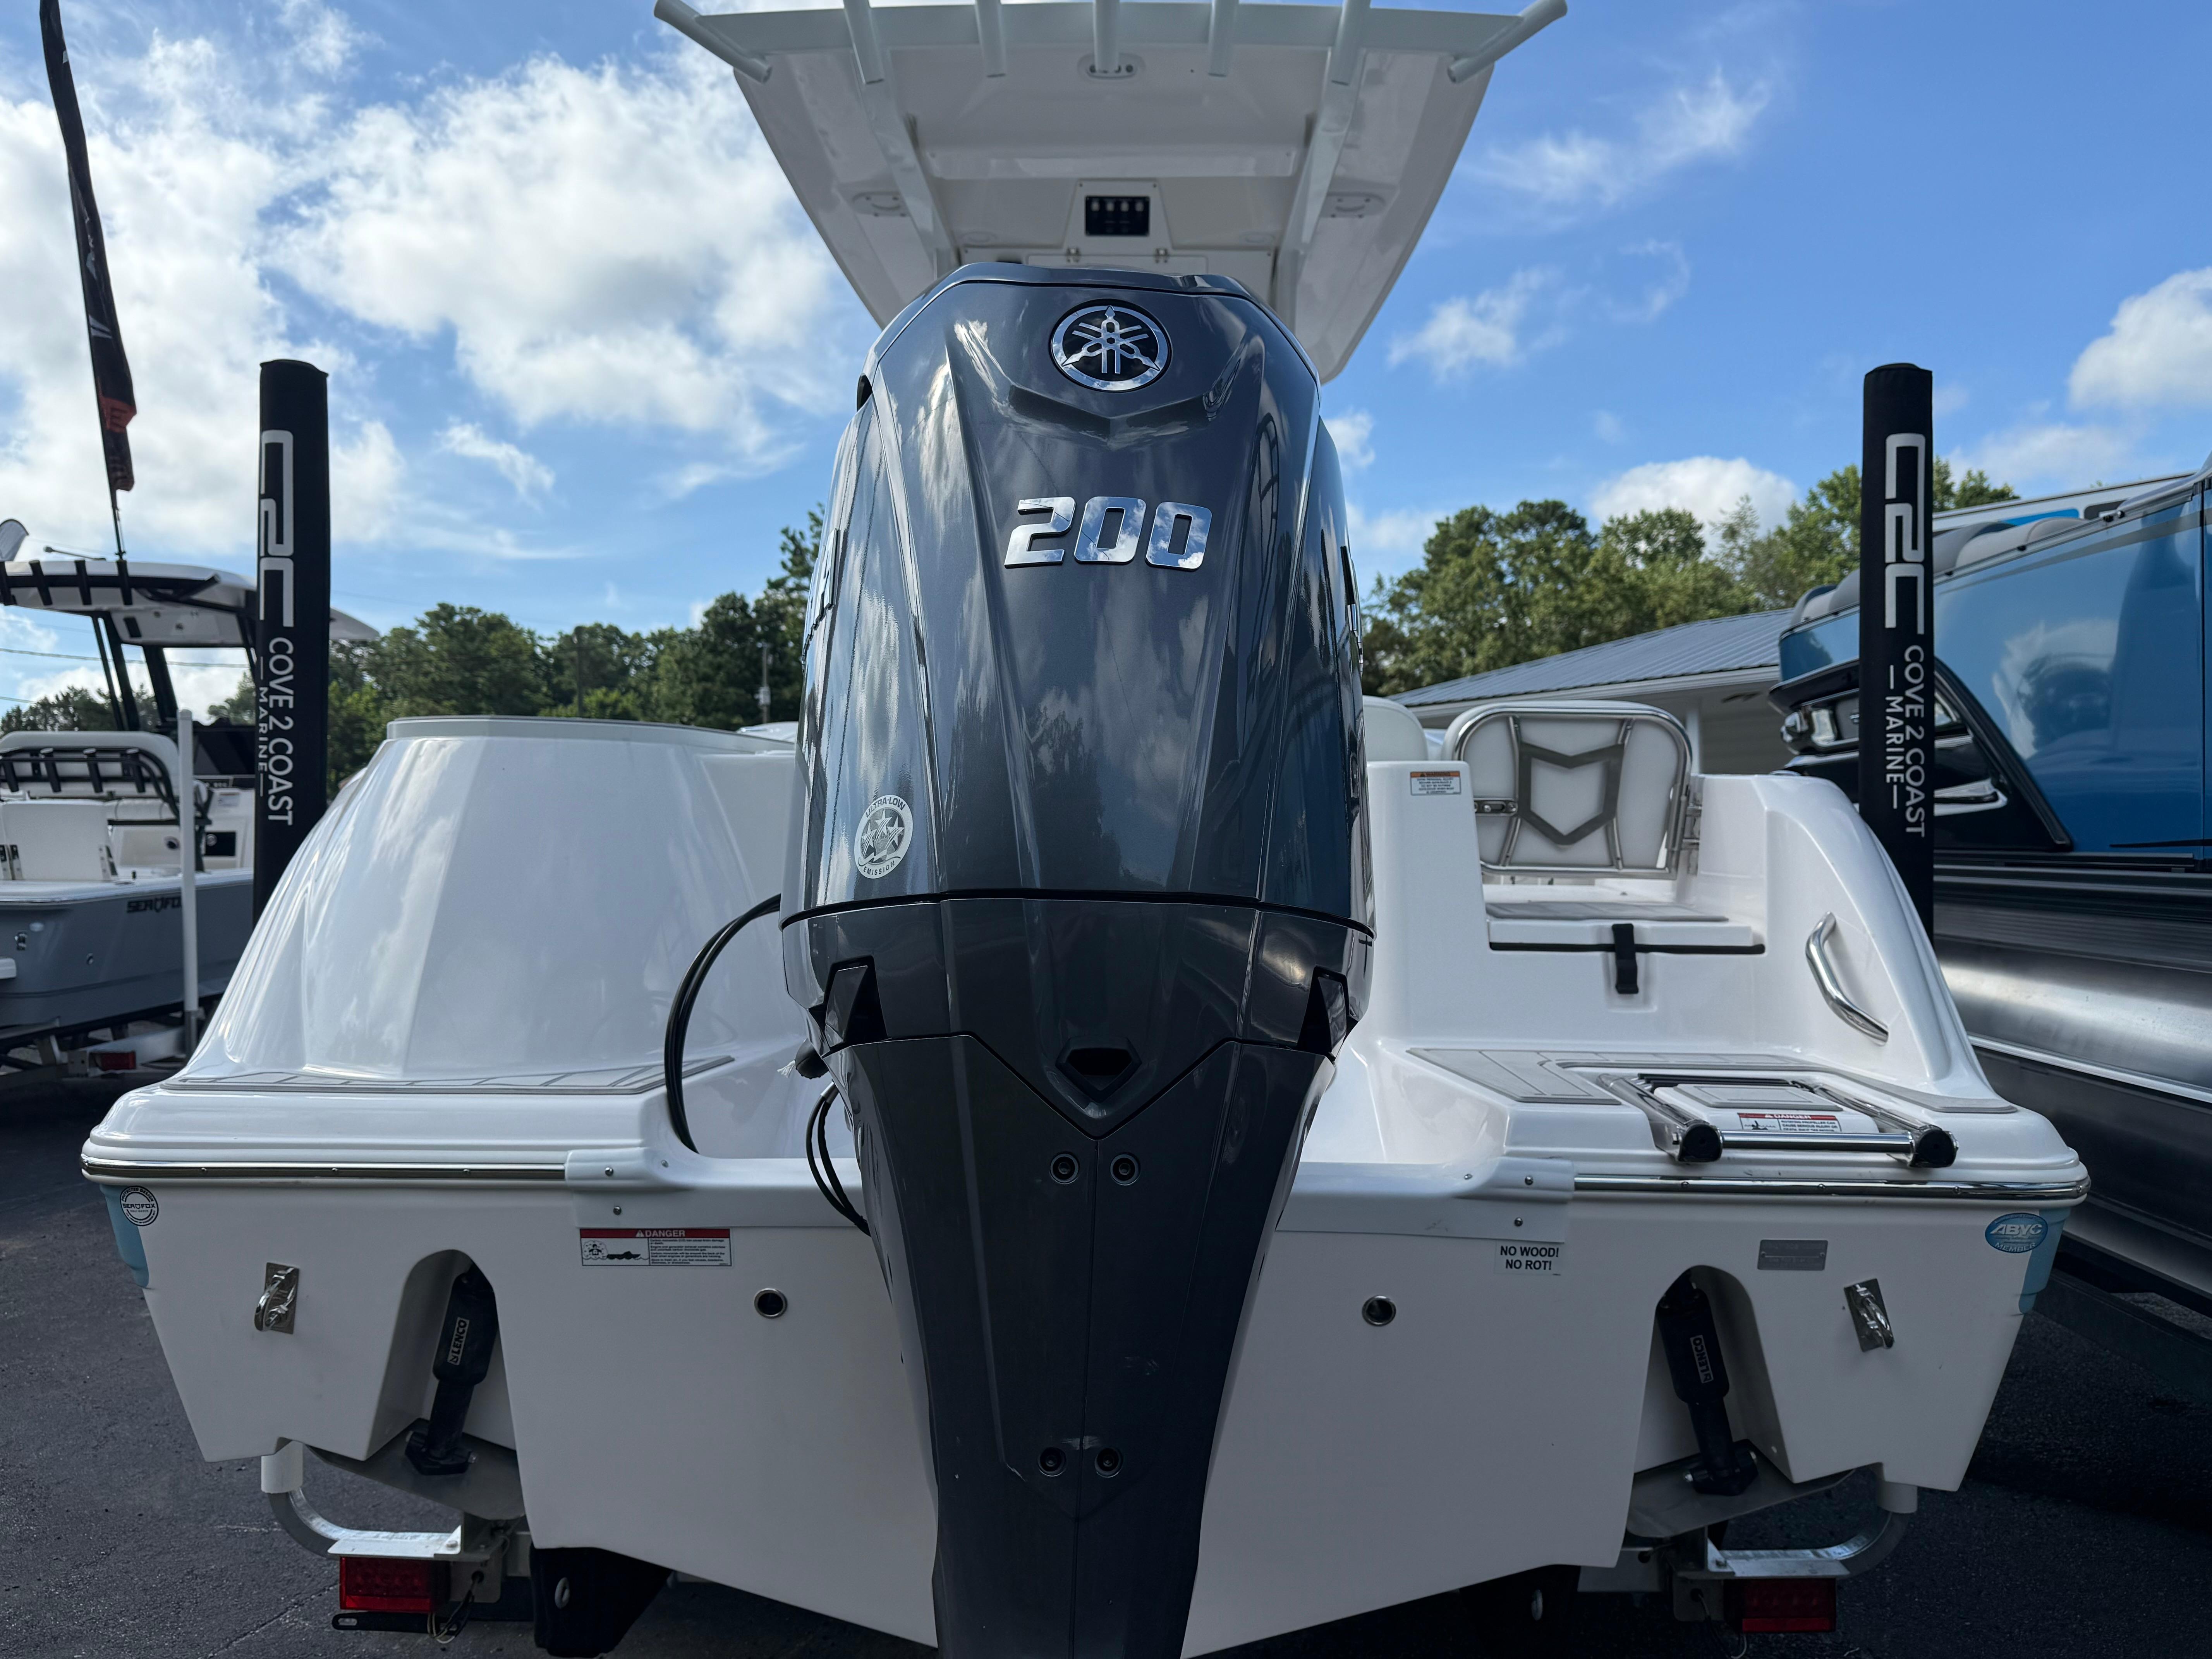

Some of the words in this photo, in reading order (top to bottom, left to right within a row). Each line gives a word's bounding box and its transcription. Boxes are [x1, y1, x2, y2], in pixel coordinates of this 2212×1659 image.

[1004, 496, 1212, 572] 200
[269, 637, 294, 709] COVE
[1904, 645, 1924, 718] COVE
[259, 687, 268, 772] MARINE
[269, 716, 294, 730] 2
[1886, 696, 1905, 783] MARINE
[1905, 725, 1924, 740] 2
[268, 738, 293, 826] COAST
[1905, 748, 1925, 837] COAST
[864, 861, 895, 876] EMISSION
[1990, 1223, 2042, 1235] ABYC
[1995, 1242, 2036, 1252] MEMBER
[1500, 1245, 1517, 1256] NO
[1520, 1246, 1559, 1257] WOOD!
[1505, 1259, 1522, 1269] NO
[1525, 1260, 1552, 1270] ROT!
[452, 1319, 467, 1355] LENCO
[1693, 1337, 1711, 1373] LENCO
